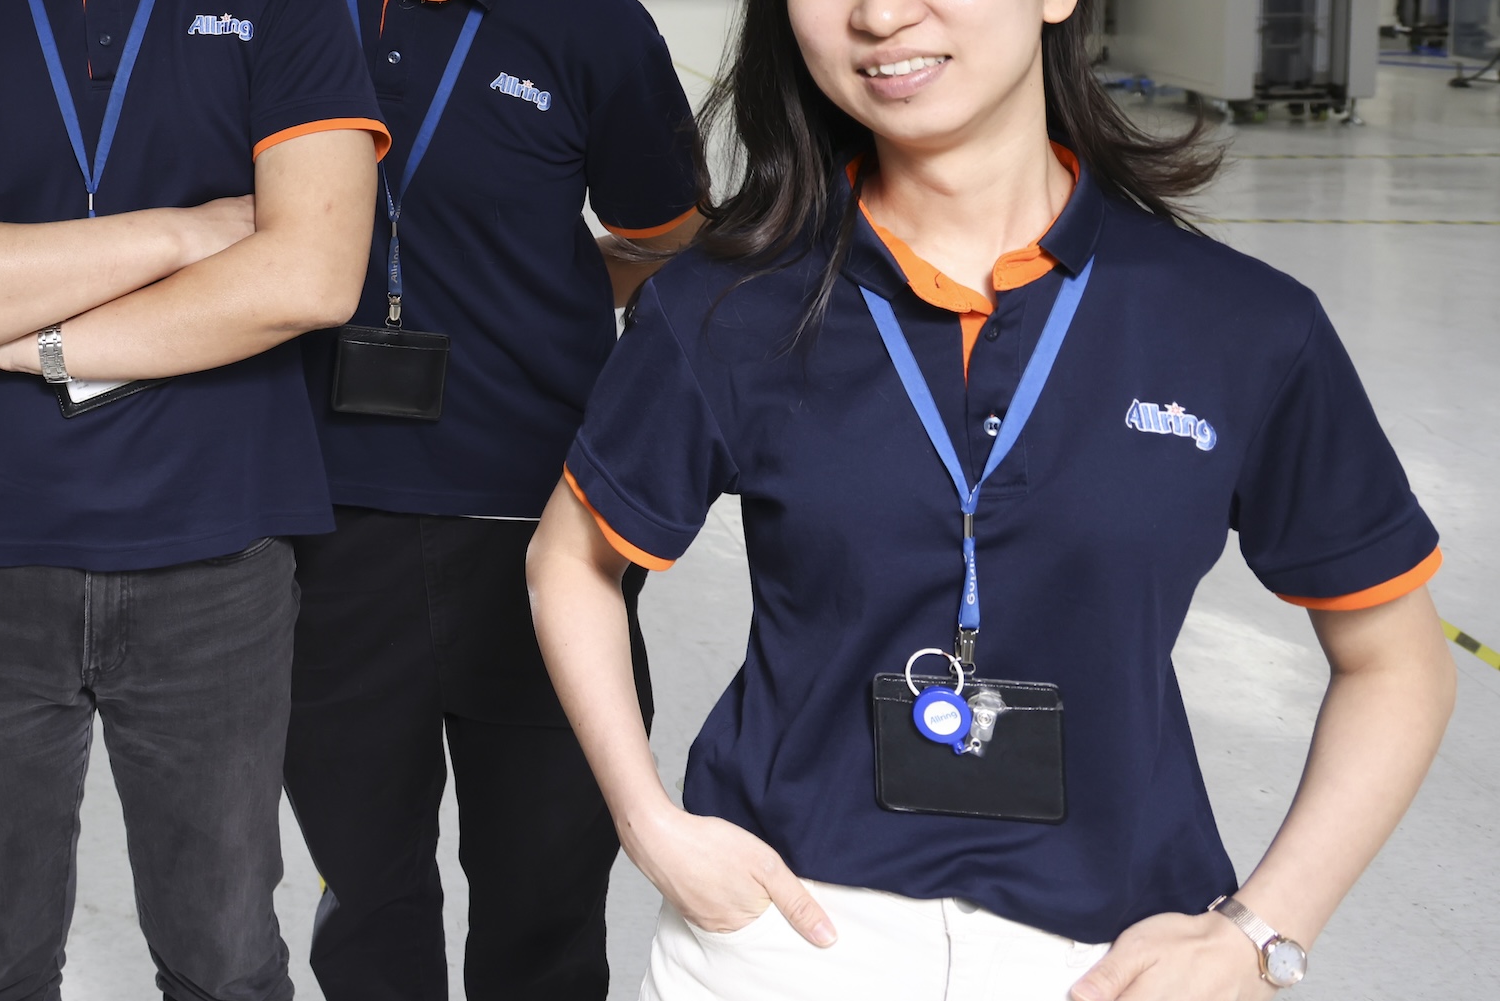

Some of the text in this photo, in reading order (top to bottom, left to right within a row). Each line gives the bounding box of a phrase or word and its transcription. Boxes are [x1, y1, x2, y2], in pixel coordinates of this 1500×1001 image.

[188, 13, 254, 41] Allring
[490, 72, 551, 111] Allring
[1125, 398, 1217, 451] Allring
[930, 711, 958, 725] Allring
